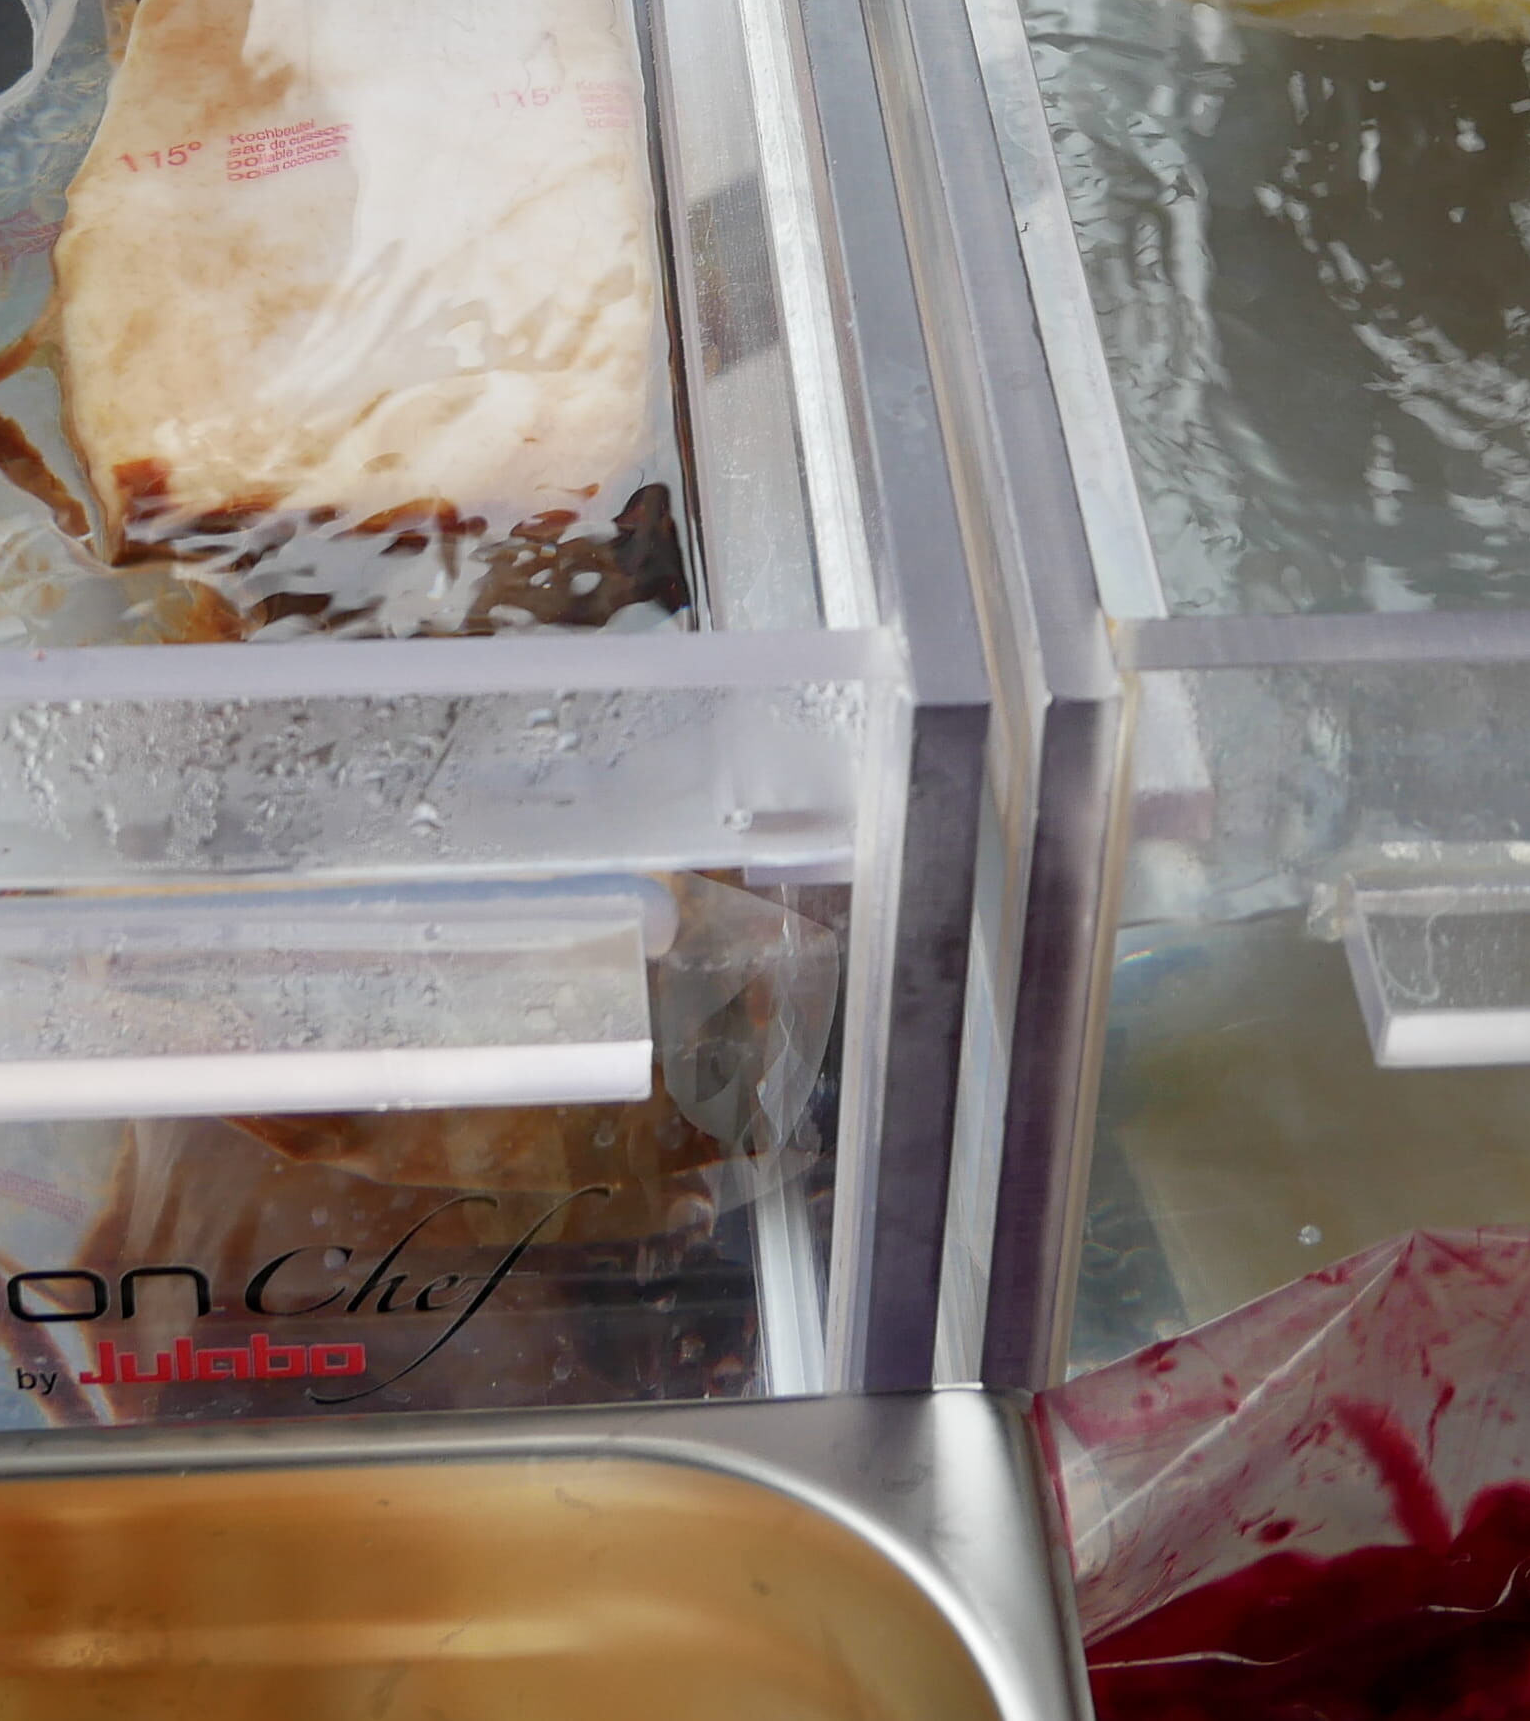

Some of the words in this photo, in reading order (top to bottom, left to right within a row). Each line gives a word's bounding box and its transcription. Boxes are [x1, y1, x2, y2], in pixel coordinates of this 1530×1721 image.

[15, 1367, 58, 1396] by
[78, 1333, 366, 1388] Julabo
[243, 1184, 612, 1404] Chef
